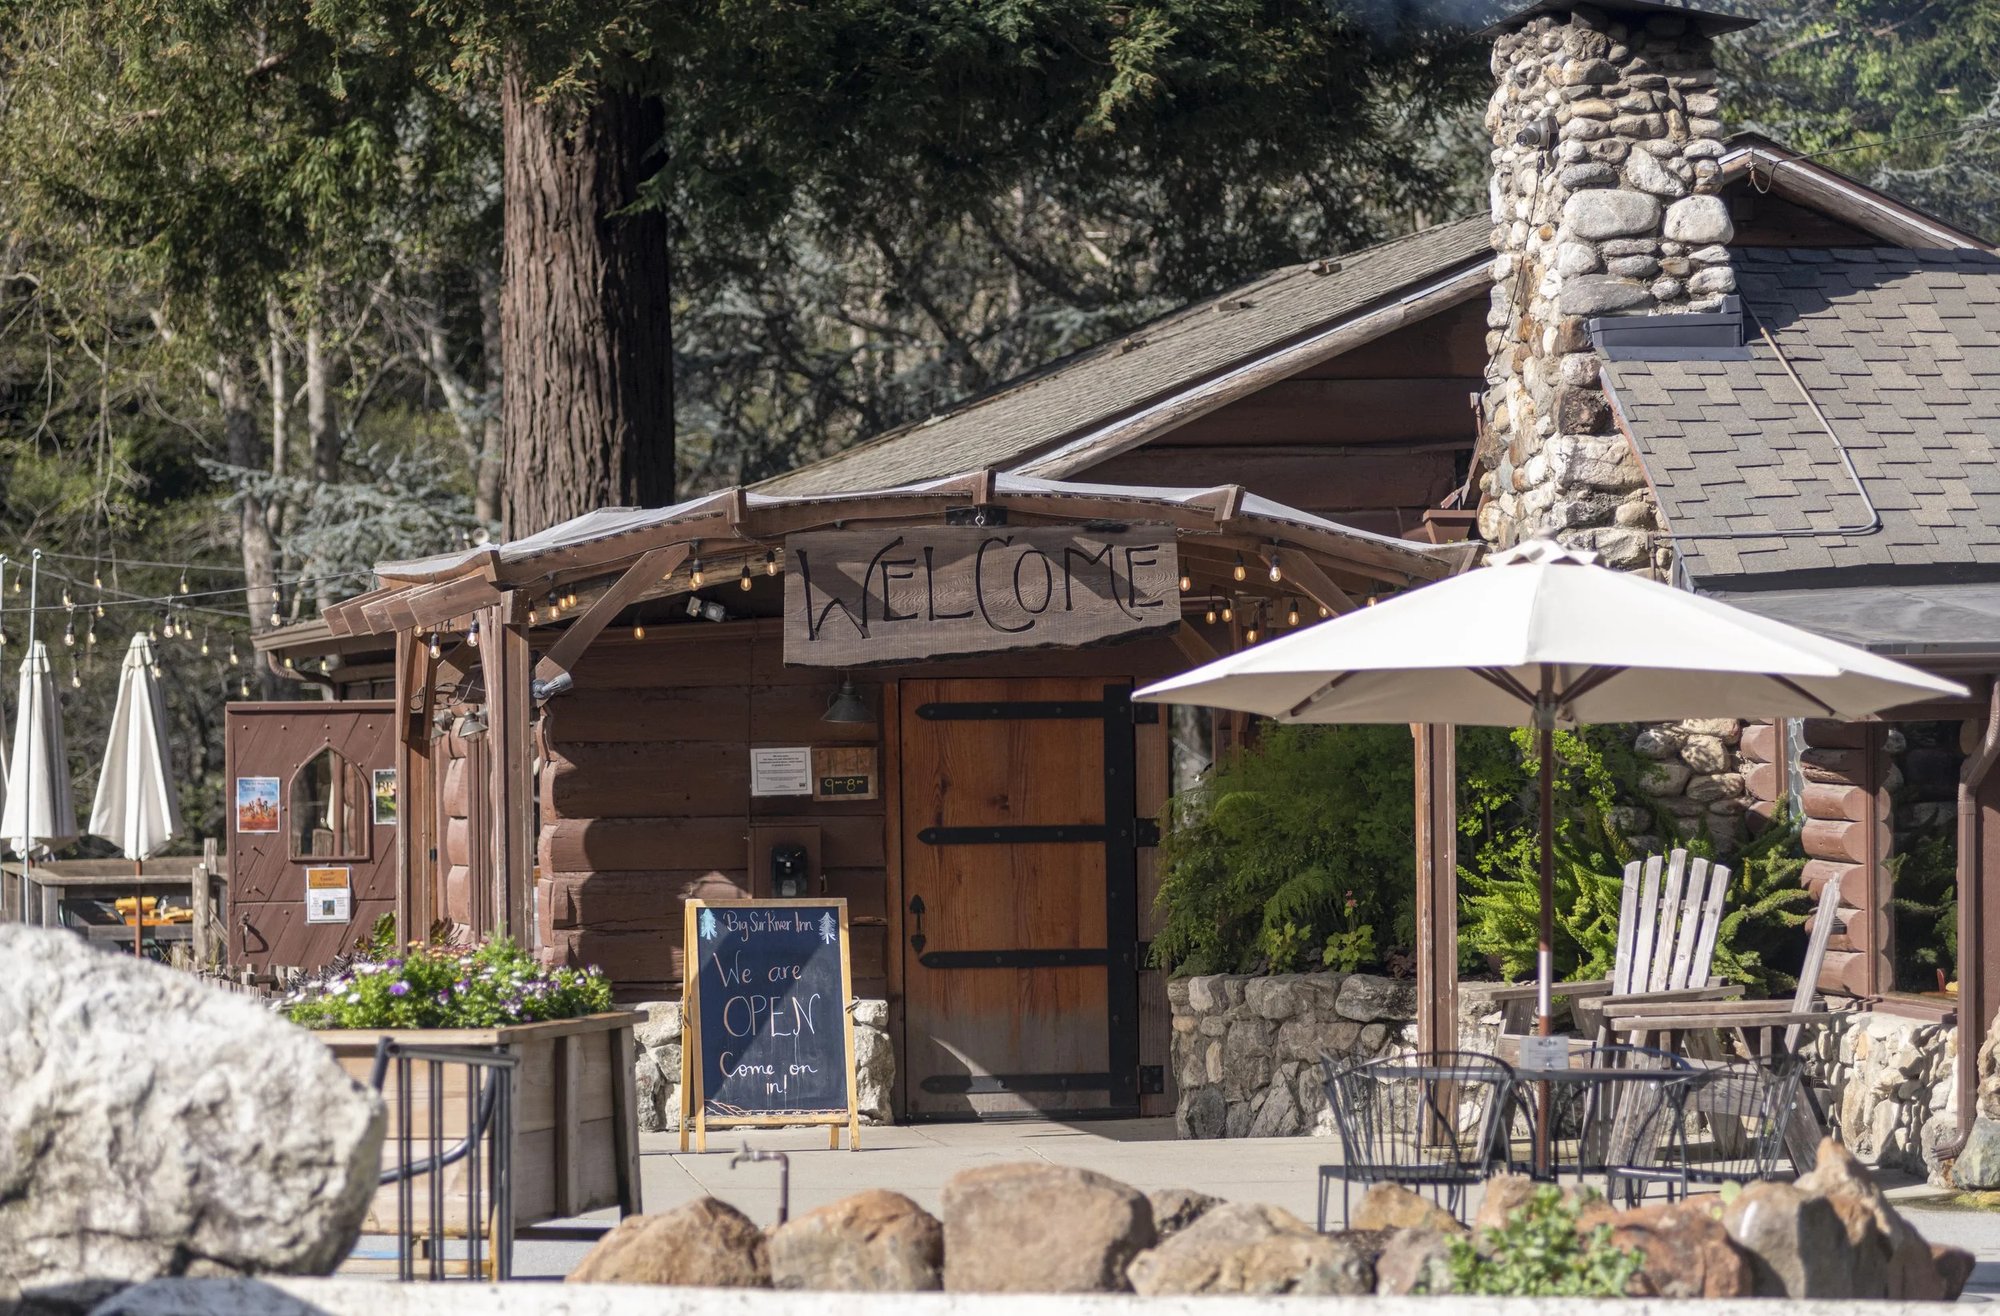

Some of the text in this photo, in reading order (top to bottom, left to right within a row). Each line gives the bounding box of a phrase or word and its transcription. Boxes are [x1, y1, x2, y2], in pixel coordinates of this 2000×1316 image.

[797, 536, 1164, 641] WELCOME
[723, 910, 814, 942] Big Sur River Inn
[713, 951, 801, 987] We are
[723, 993, 820, 1037] OPEN
[719, 1051, 818, 1077] Come on
[766, 1074, 787, 1094] in!
